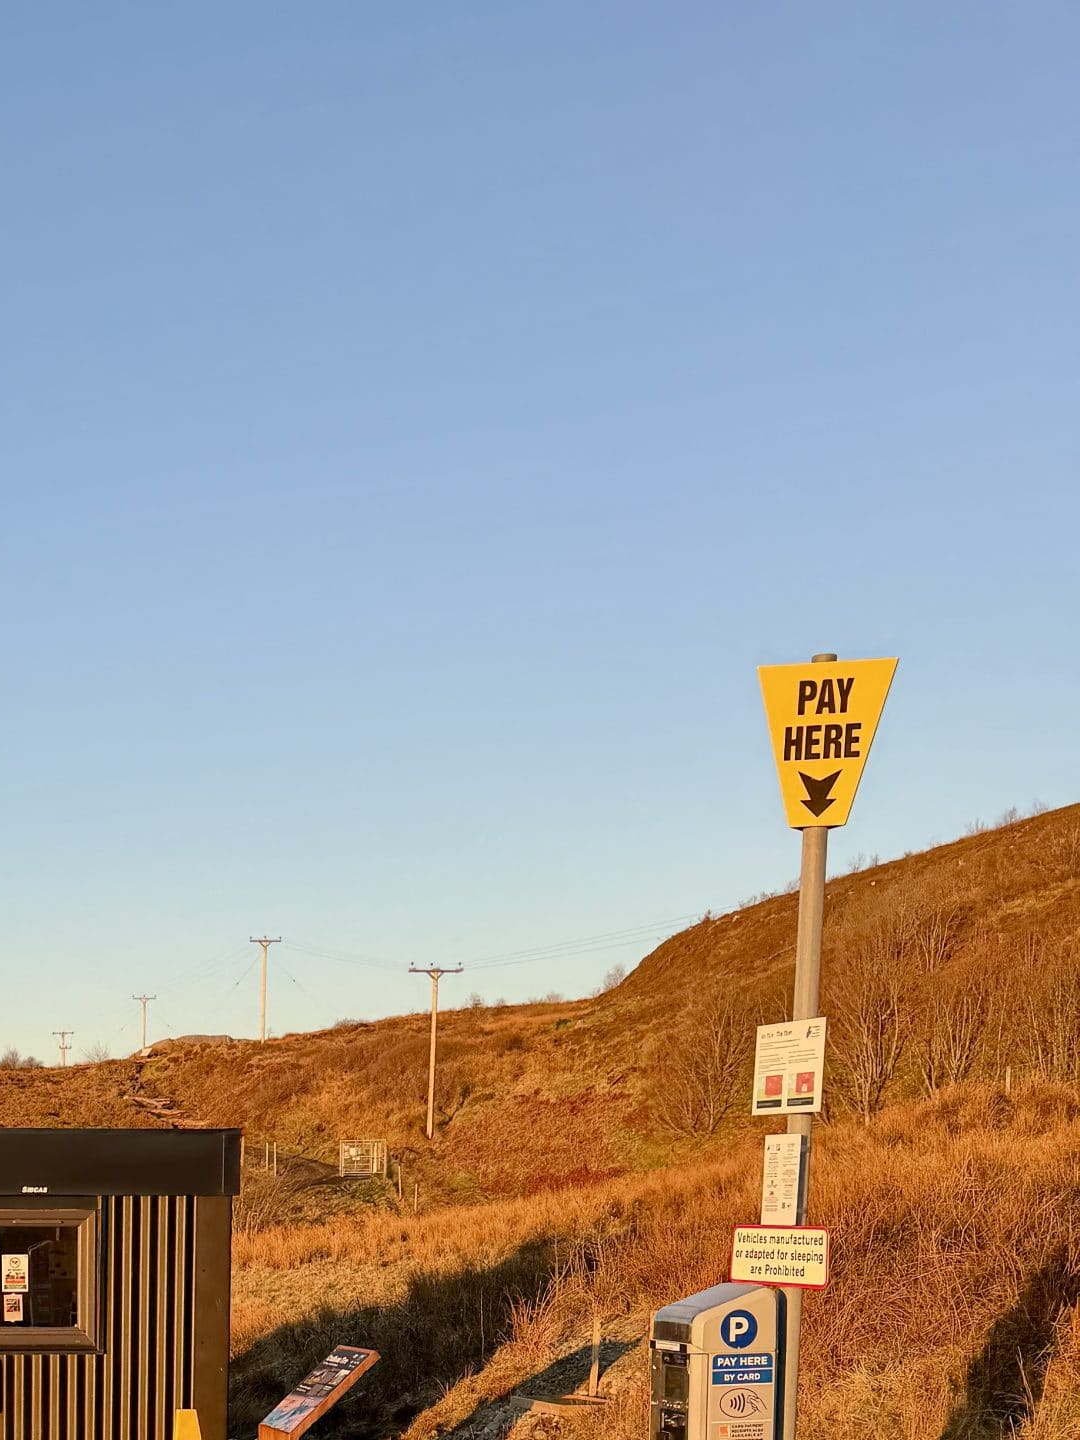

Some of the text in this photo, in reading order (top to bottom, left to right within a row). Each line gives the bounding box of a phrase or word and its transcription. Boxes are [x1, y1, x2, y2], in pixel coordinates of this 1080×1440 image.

[797, 677, 855, 716] PAY
[783, 722, 862, 762] HERE
[737, 1232, 824, 1246] Vehicles manufactured
[735, 1249, 824, 1264] or adapted for sleeping
[750, 1264, 805, 1277] are Prohibited
[730, 1316, 749, 1342] P
[717, 1356, 768, 1367] PAY HERE
[724, 1373, 761, 1382] BY CARD
